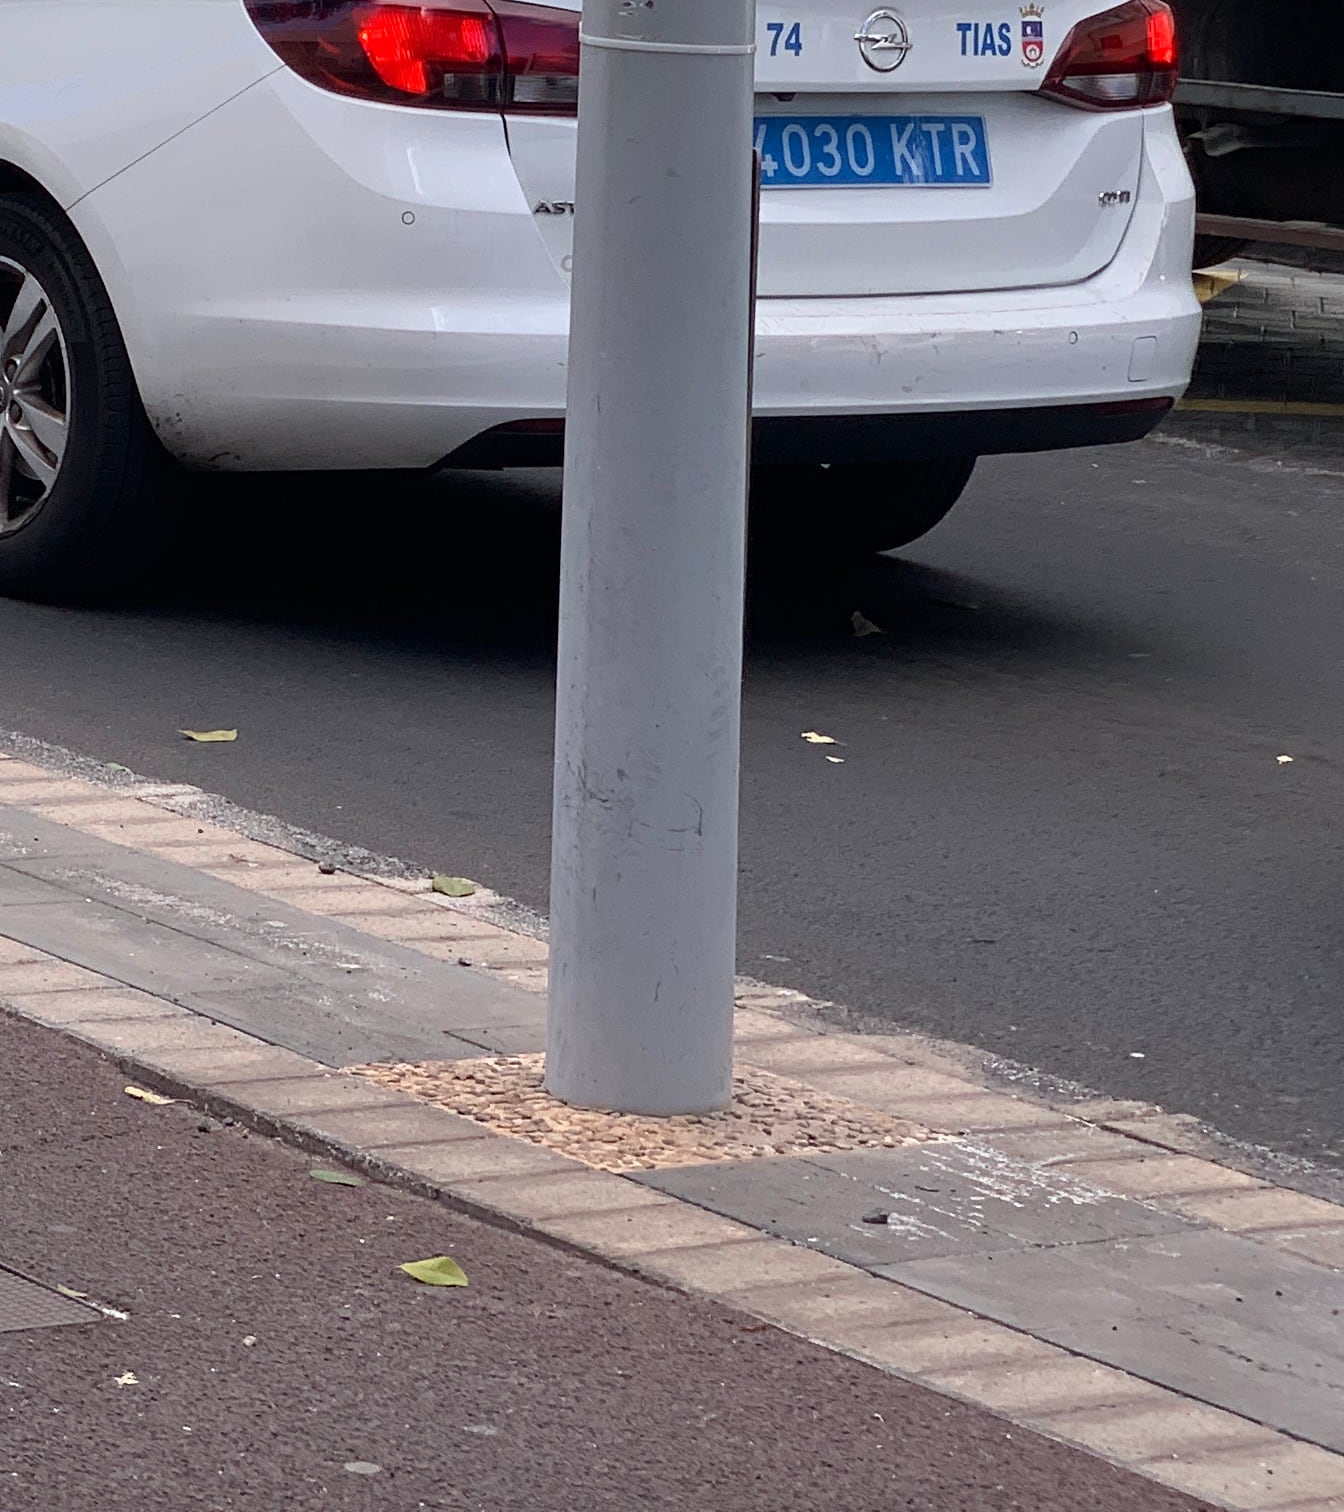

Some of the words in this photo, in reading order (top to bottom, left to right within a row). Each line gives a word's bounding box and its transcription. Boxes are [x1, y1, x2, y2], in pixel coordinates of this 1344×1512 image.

[767, 23, 802, 56] 74
[956, 22, 1012, 56] TIAS
[891, 123, 981, 177] KTR
